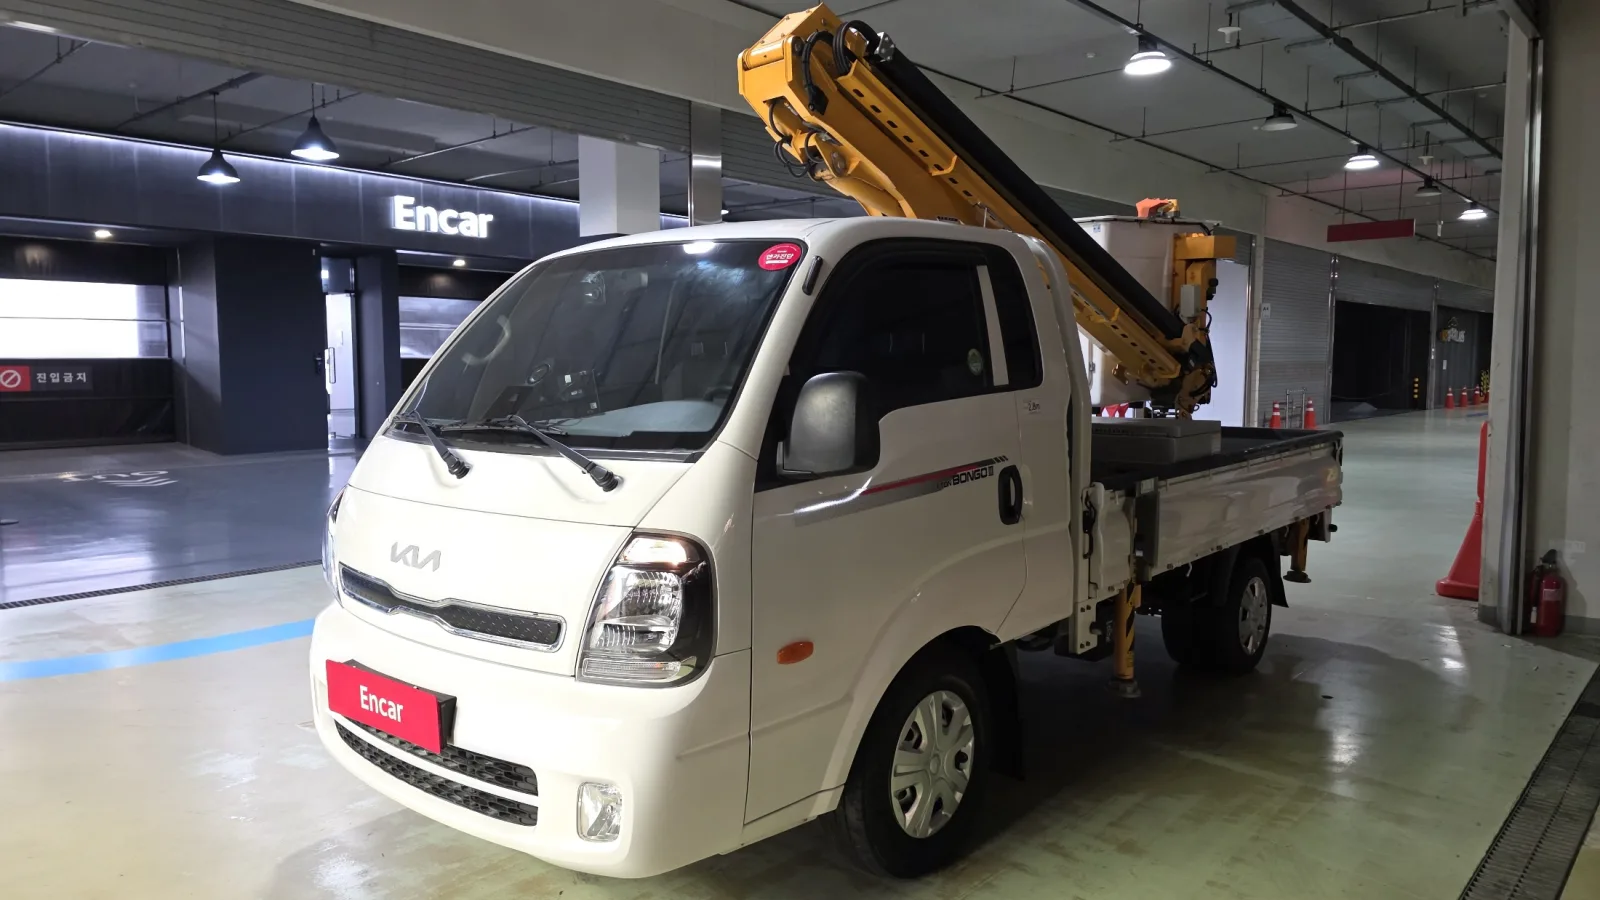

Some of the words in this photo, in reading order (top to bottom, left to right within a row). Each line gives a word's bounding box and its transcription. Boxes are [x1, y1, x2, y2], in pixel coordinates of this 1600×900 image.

[391, 195, 494, 238] Encar
[36, 372, 87, 383] 진입금지
[952, 467, 988, 486] BONGO
[390, 541, 441, 572] KIA
[359, 684, 404, 723] Encar
